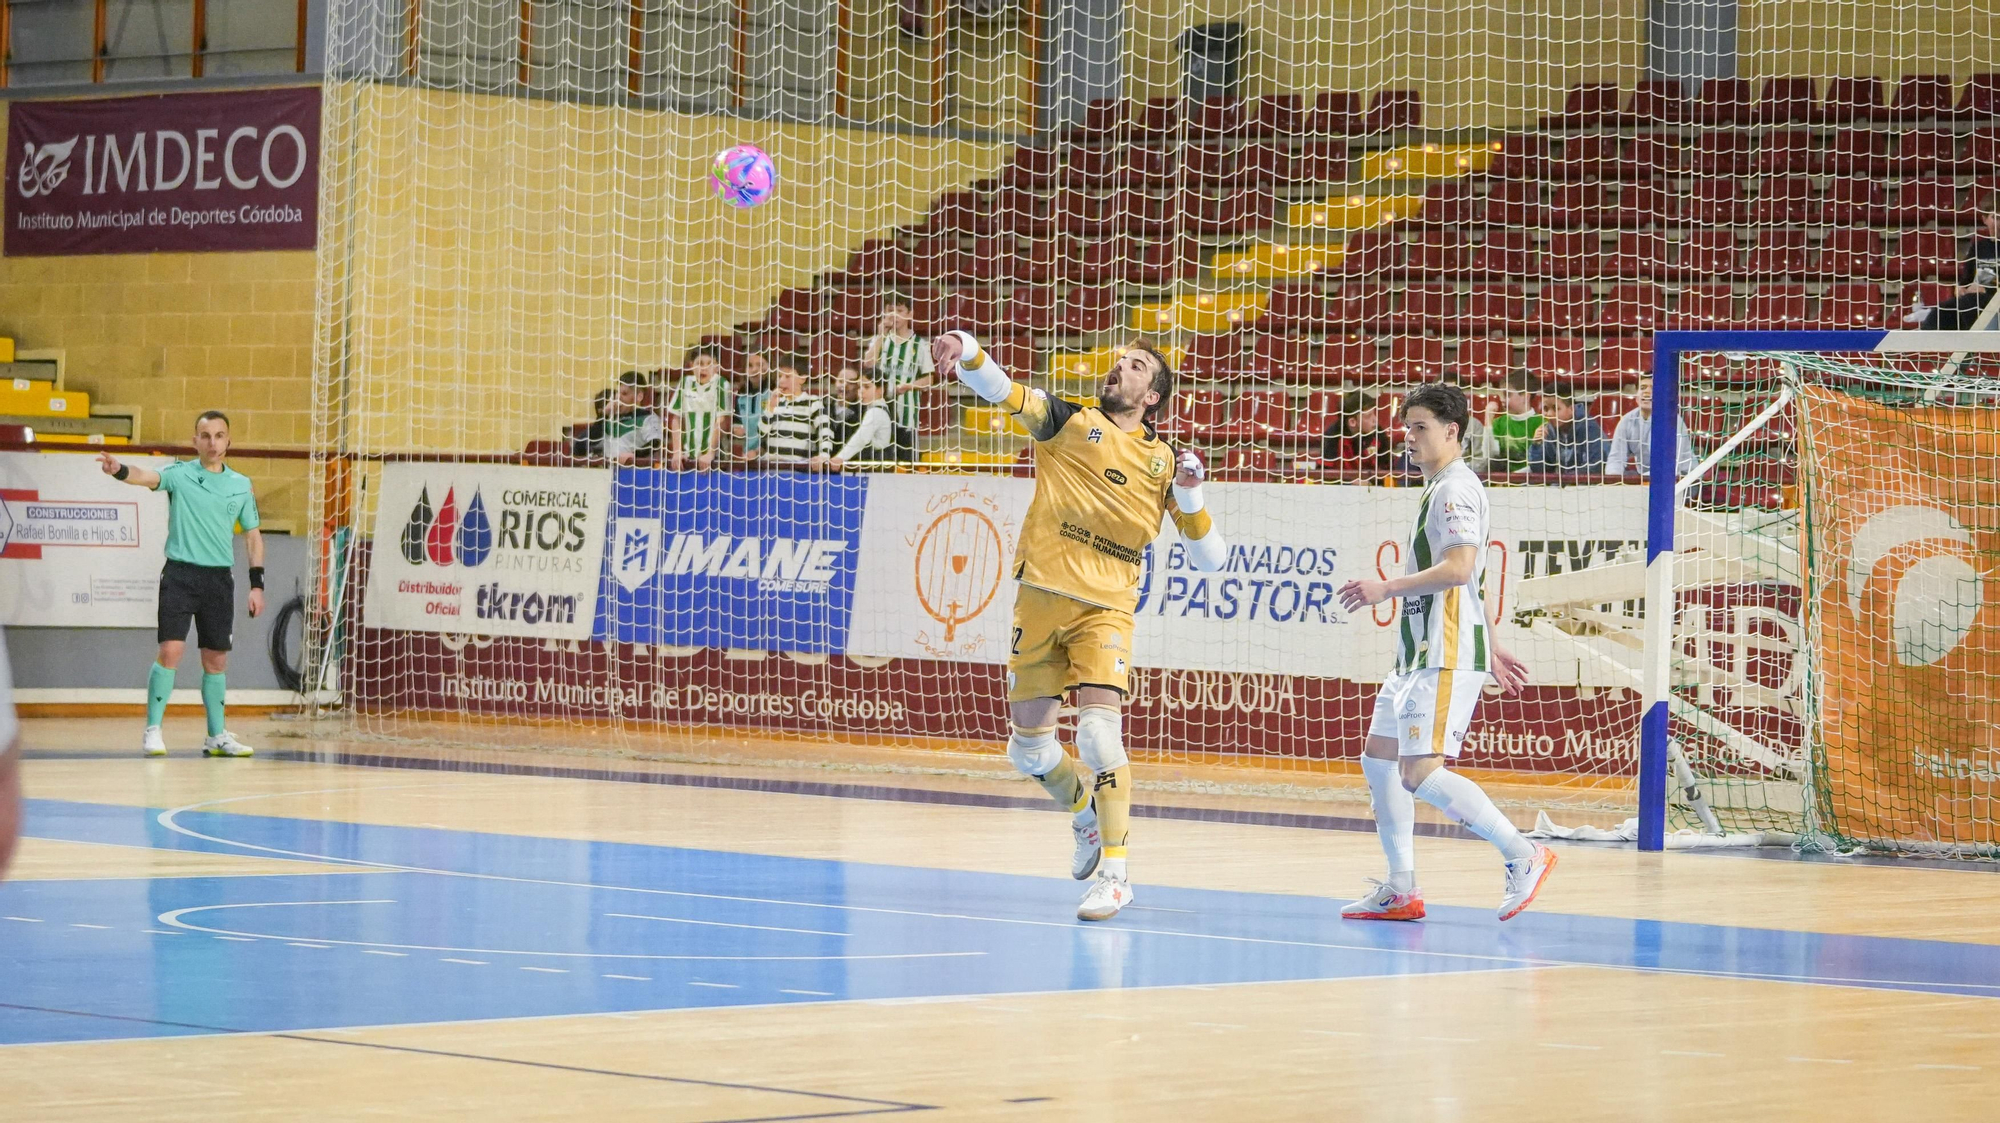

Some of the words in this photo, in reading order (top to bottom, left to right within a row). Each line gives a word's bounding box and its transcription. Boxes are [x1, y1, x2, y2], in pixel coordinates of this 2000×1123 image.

[82, 125, 307, 194] IMDECO
[18, 212, 74, 229] Instituto
[77, 209, 145, 231] Municipal
[149, 208, 167, 226] de
[171, 207, 236, 229] Deportes
[240, 204, 303, 223] Córdoba
[502, 489, 589, 509] COMERCIAL
[28, 507, 118, 520] CONSTRUCCIONES
[926, 483, 976, 513] Copita
[1003, 514, 1016, 555] Vino
[16, 523, 46, 540] Rafael
[48, 525, 80, 540] Bonilla
[82, 529, 89, 540] e
[91, 527, 118, 544] Hijos,
[662, 534, 849, 581] IMANE
[1092, 542, 1141, 566] HUMANIDAD
[1094, 535, 1138, 557] PATRIMONIO
[495, 553, 584, 573] PINTURAS
[398, 580, 462, 596] Distribuidor
[425, 601, 461, 616] Oficial
[1158, 576, 1334, 624] PASTOR
[440, 674, 527, 701] Instituto
[534, 677, 644, 712] Municipal
[651, 684, 680, 707] de
[687, 683, 794, 717] Deportes
[801, 689, 904, 721] Córdoba
